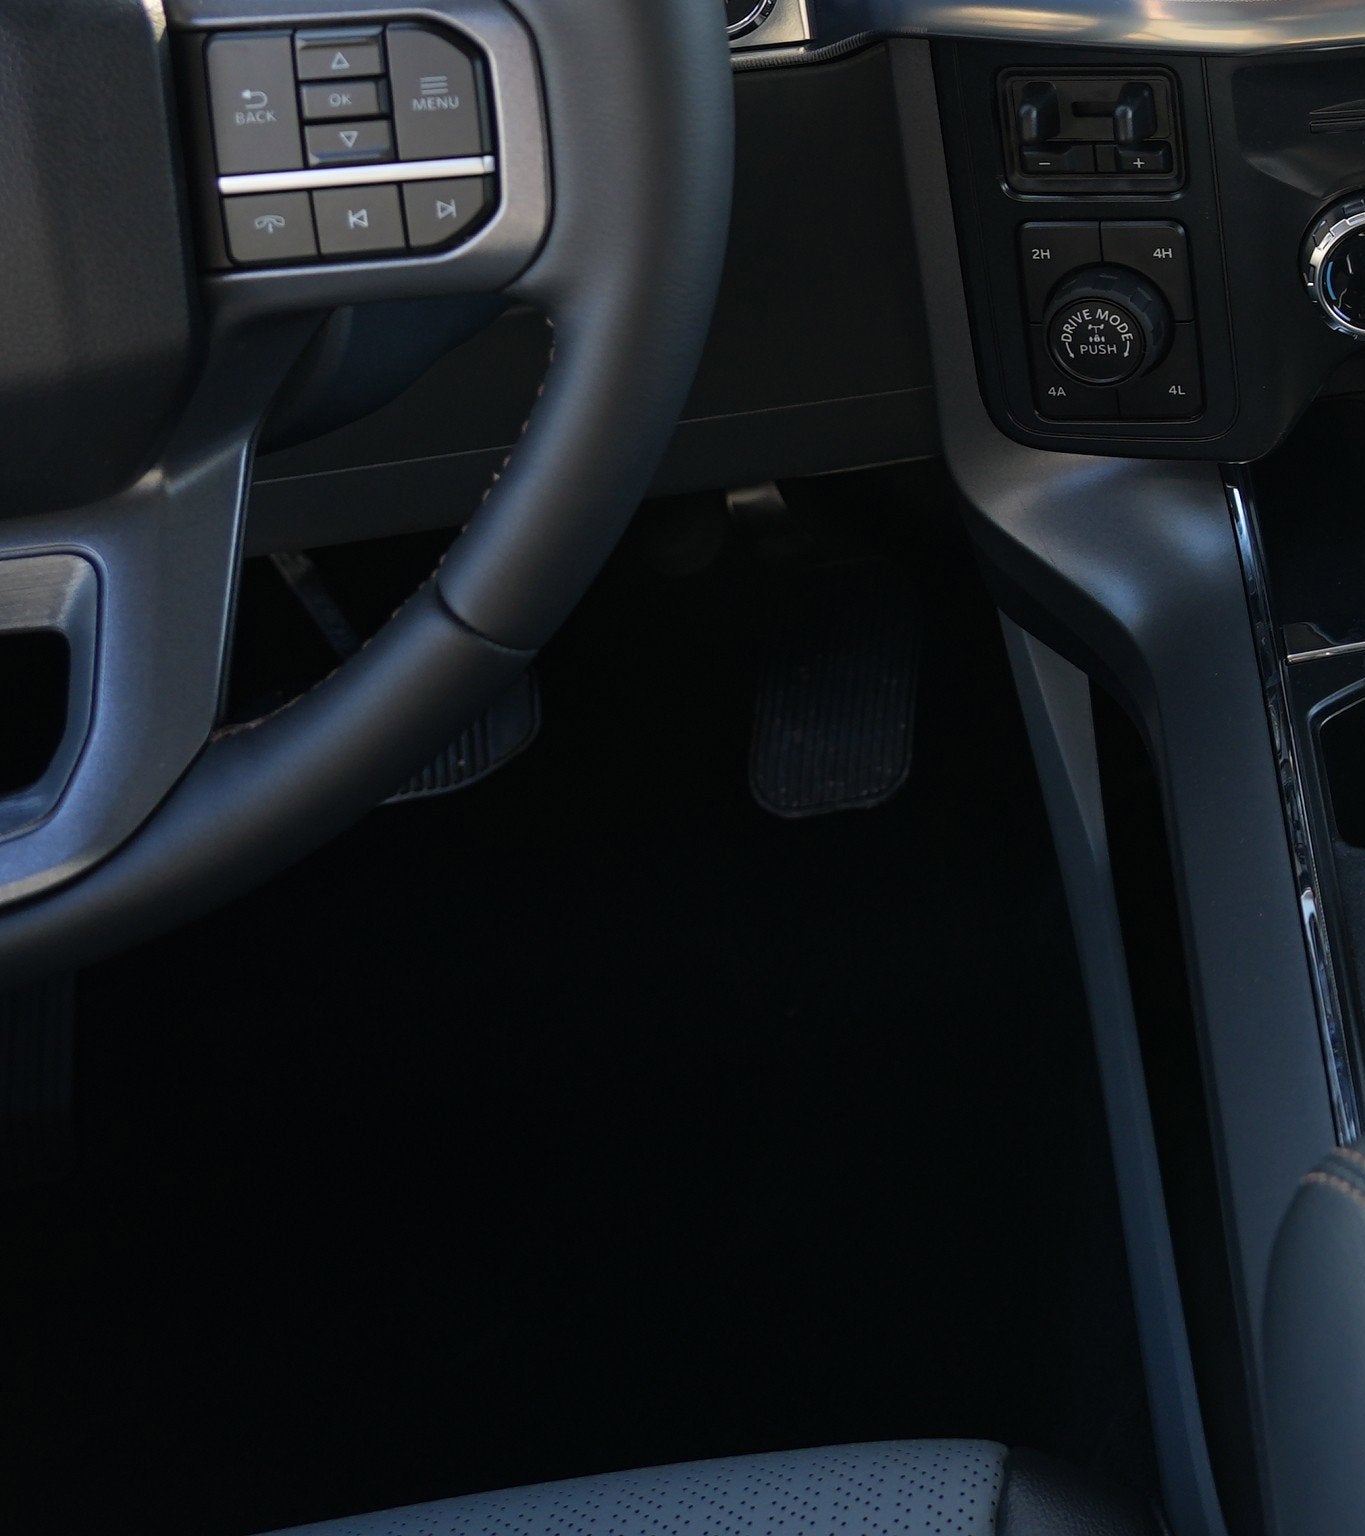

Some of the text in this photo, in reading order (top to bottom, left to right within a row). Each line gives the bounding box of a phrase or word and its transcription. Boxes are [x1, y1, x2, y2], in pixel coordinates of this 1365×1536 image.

[329, 93, 352, 107] OK
[412, 95, 459, 112] MENU
[235, 110, 278, 125] BACK
[1031, 248, 1051, 260] 2H
[1153, 248, 1173, 259] 4H
[1061, 308, 1134, 343] DRIVE MODE
[1080, 344, 1117, 355] PUSH
[1048, 386, 1067, 397] 4A
[1168, 385, 1186, 396] 4L
